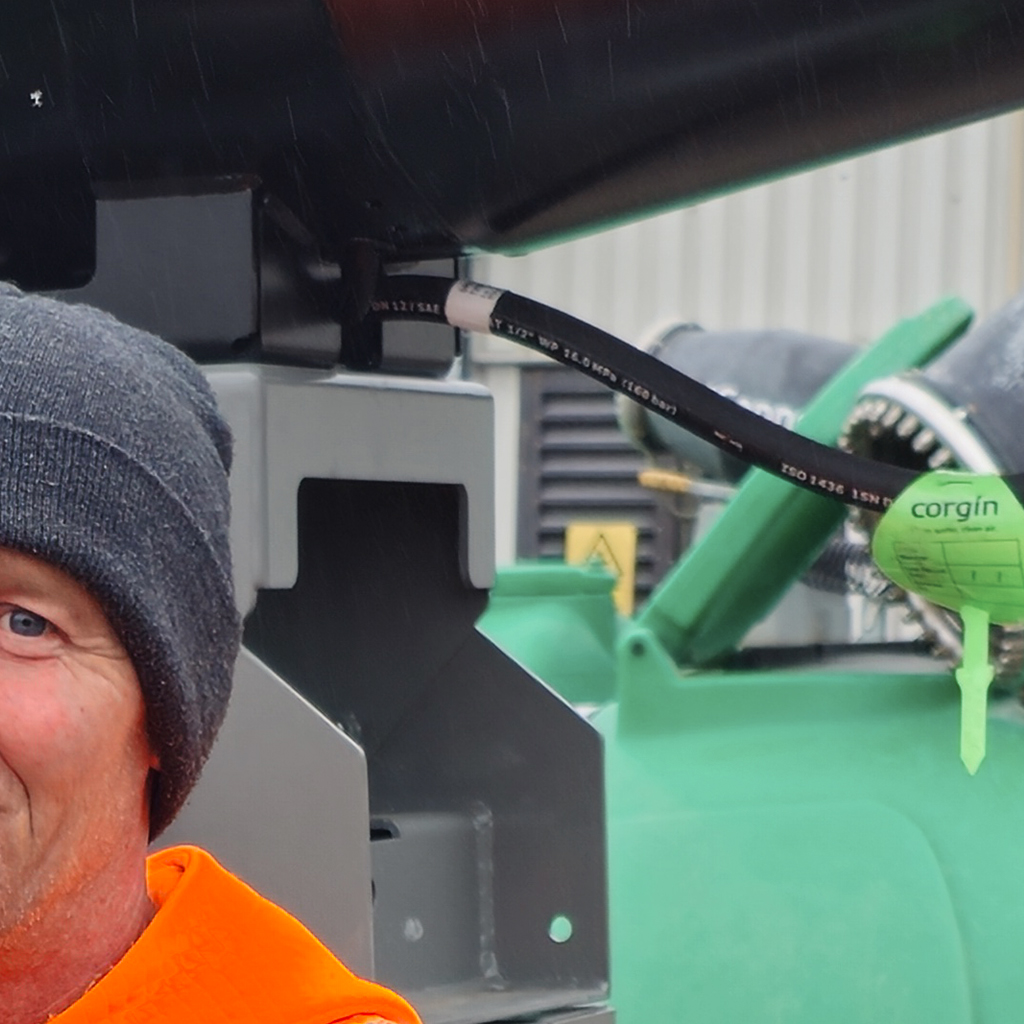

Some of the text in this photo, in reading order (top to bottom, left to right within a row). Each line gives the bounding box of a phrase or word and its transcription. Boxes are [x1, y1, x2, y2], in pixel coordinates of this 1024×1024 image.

[538, 335, 559, 351] WP
[650, 394, 677, 415] bar)
[781, 463, 807, 481] ISO
[810, 475, 845, 495] 1436
